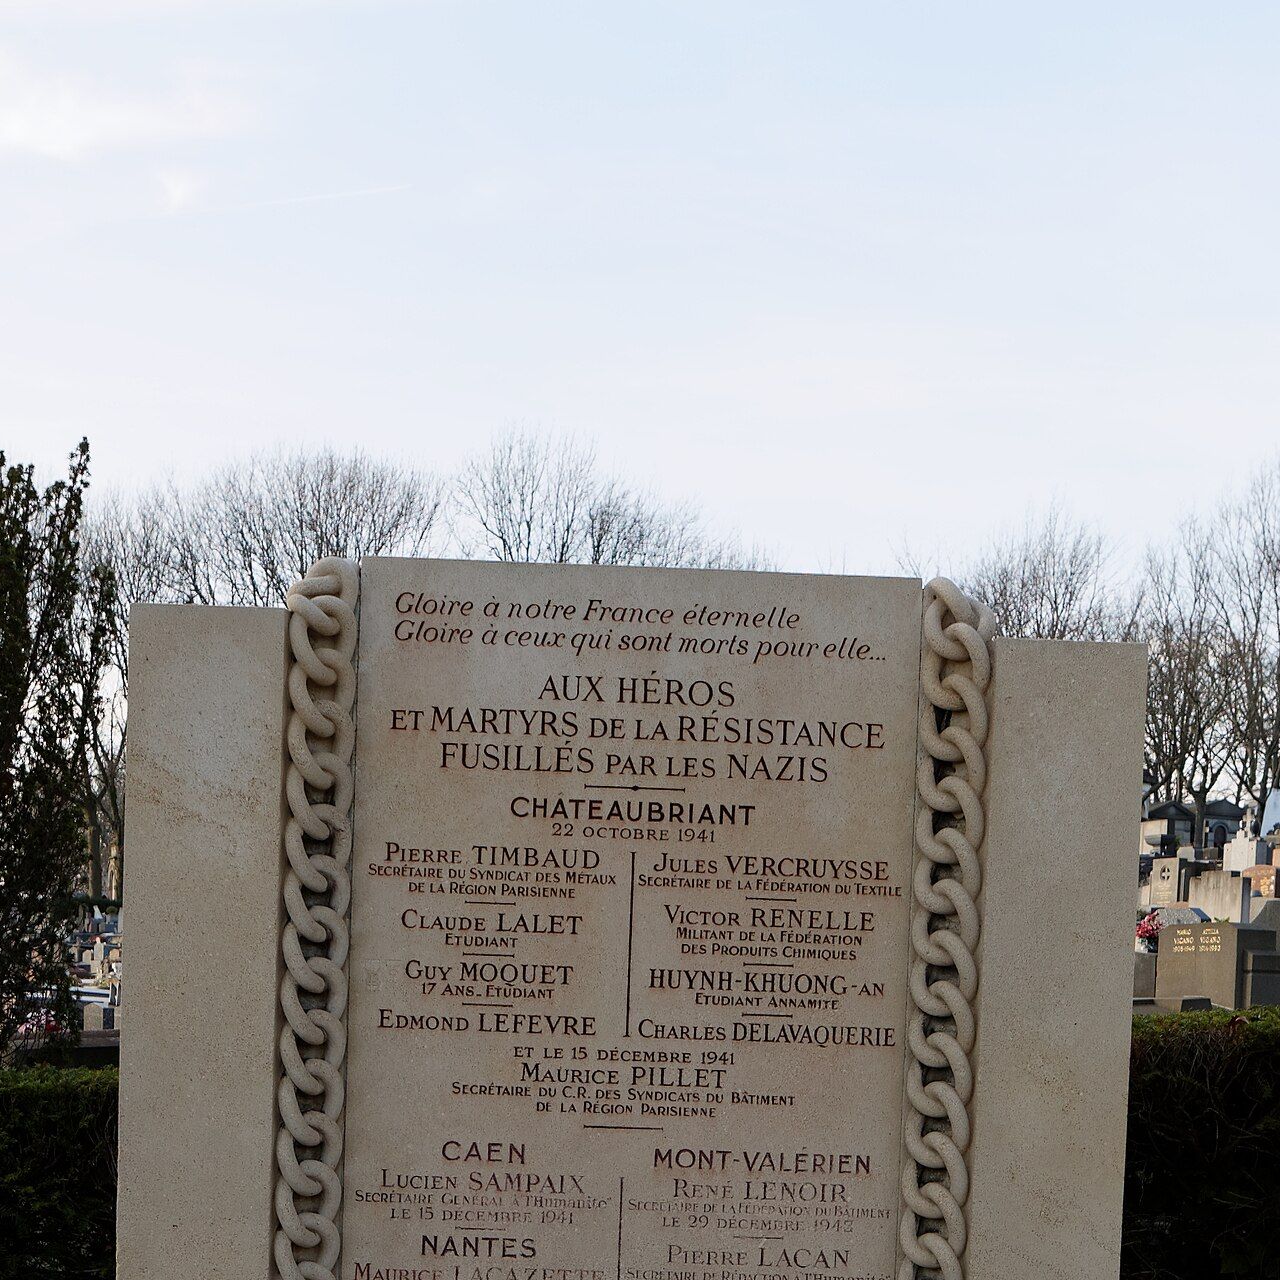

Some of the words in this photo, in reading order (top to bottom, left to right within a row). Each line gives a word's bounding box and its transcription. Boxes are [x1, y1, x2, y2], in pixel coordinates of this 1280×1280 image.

[396, 592, 473, 617] Gloire
[484, 596, 499, 618] à
[508, 600, 576, 620] notre
[584, 599, 673, 624] France
[683, 604, 800, 629] éternelle
[395, 620, 473, 644] Gloire
[482, 624, 498, 645] à
[505, 630, 565, 648] ceux
[571, 629, 613, 656] qui
[618, 632, 672, 652] sont
[679, 635, 748, 655] morts
[753, 640, 819, 664] pour
[538, 675, 605, 702] AUX
[617, 671, 735, 707] HÉROS
[390, 709, 424, 730] ET
[430, 706, 578, 737] MARTYRS
[589, 718, 626, 739] DE
[634, 719, 669, 740] LA
[677, 710, 885, 749] RÉSISTANCE
[440, 741, 594, 774] FUSILLÉS
[605, 754, 658, 776] PAR
[667, 756, 716, 778] LES
[727, 754, 828, 782] NAZIS
[552, 822, 574, 837] 22
[583, 827, 670, 841] OCTOBRE
[678, 828, 715, 843] 1941
[384, 841, 462, 864] PIERRE
[472, 845, 600, 869] TIMBAUD
[653, 852, 718, 873] JULES
[725, 855, 890, 881] VERCRUYSSE
[368, 863, 443, 879] SECRÉTAIRE
[448, 868, 466, 880] DU
[470, 867, 532, 882] SYNDICAT
[536, 871, 560, 883] DES
[565, 870, 616, 885] MÉTAUX
[638, 874, 711, 889] SECRÉTAIRE
[716, 879, 732, 889] DE
[737, 880, 752, 890] LA
[756, 878, 830, 893] FÉDÉRATION
[835, 884, 852, 894] DU
[855, 882, 901, 897] TEXTILE
[408, 882, 425, 893] DE
[430, 882, 445, 894] LA
[450, 880, 496, 896] RÉGION
[501, 883, 576, 899] PARISIENNE
[401, 908, 486, 931] CLAUDE
[497, 912, 583, 935] LALET
[664, 904, 740, 926] VICTOR
[751, 908, 875, 932] RENELLE
[445, 933, 518, 948] ETUDIANT
[405, 959, 452, 981] GUY
[459, 962, 574, 987] MOQUET
[421, 982, 435, 995] 17
[486, 984, 556, 999] ETUDIANT
[695, 992, 763, 1007] ETUDIANT
[768, 996, 839, 1010] ANNAMITE
[378, 1008, 469, 1031] EDMOND
[478, 1013, 597, 1036] LEFEVRE
[638, 1018, 726, 1041] CHARLES
[732, 1022, 896, 1048] DELAVAQUERIE
[513, 1046, 534, 1058] ET
[543, 1047, 564, 1059] LE
[572, 1047, 588, 1060] 15
[597, 1046, 691, 1064] DÉCEMBRE
[701, 1052, 735, 1065] 1941
[520, 1062, 619, 1085] MAURICE
[631, 1066, 726, 1088] PILLET
[442, 1140, 526, 1164] CAEN
[653, 1147, 871, 1175] MONT-VALÉRIEN
[381, 1168, 457, 1190] LUCIEN
[468, 1172, 586, 1195] SAMPAIX
[673, 1178, 734, 1199] RENÉ
[744, 1181, 849, 1203] LENOIR
[421, 1235, 537, 1259] NANTES
[667, 1244, 748, 1266] PIERRE
[758, 1247, 850, 1269] LACAN
